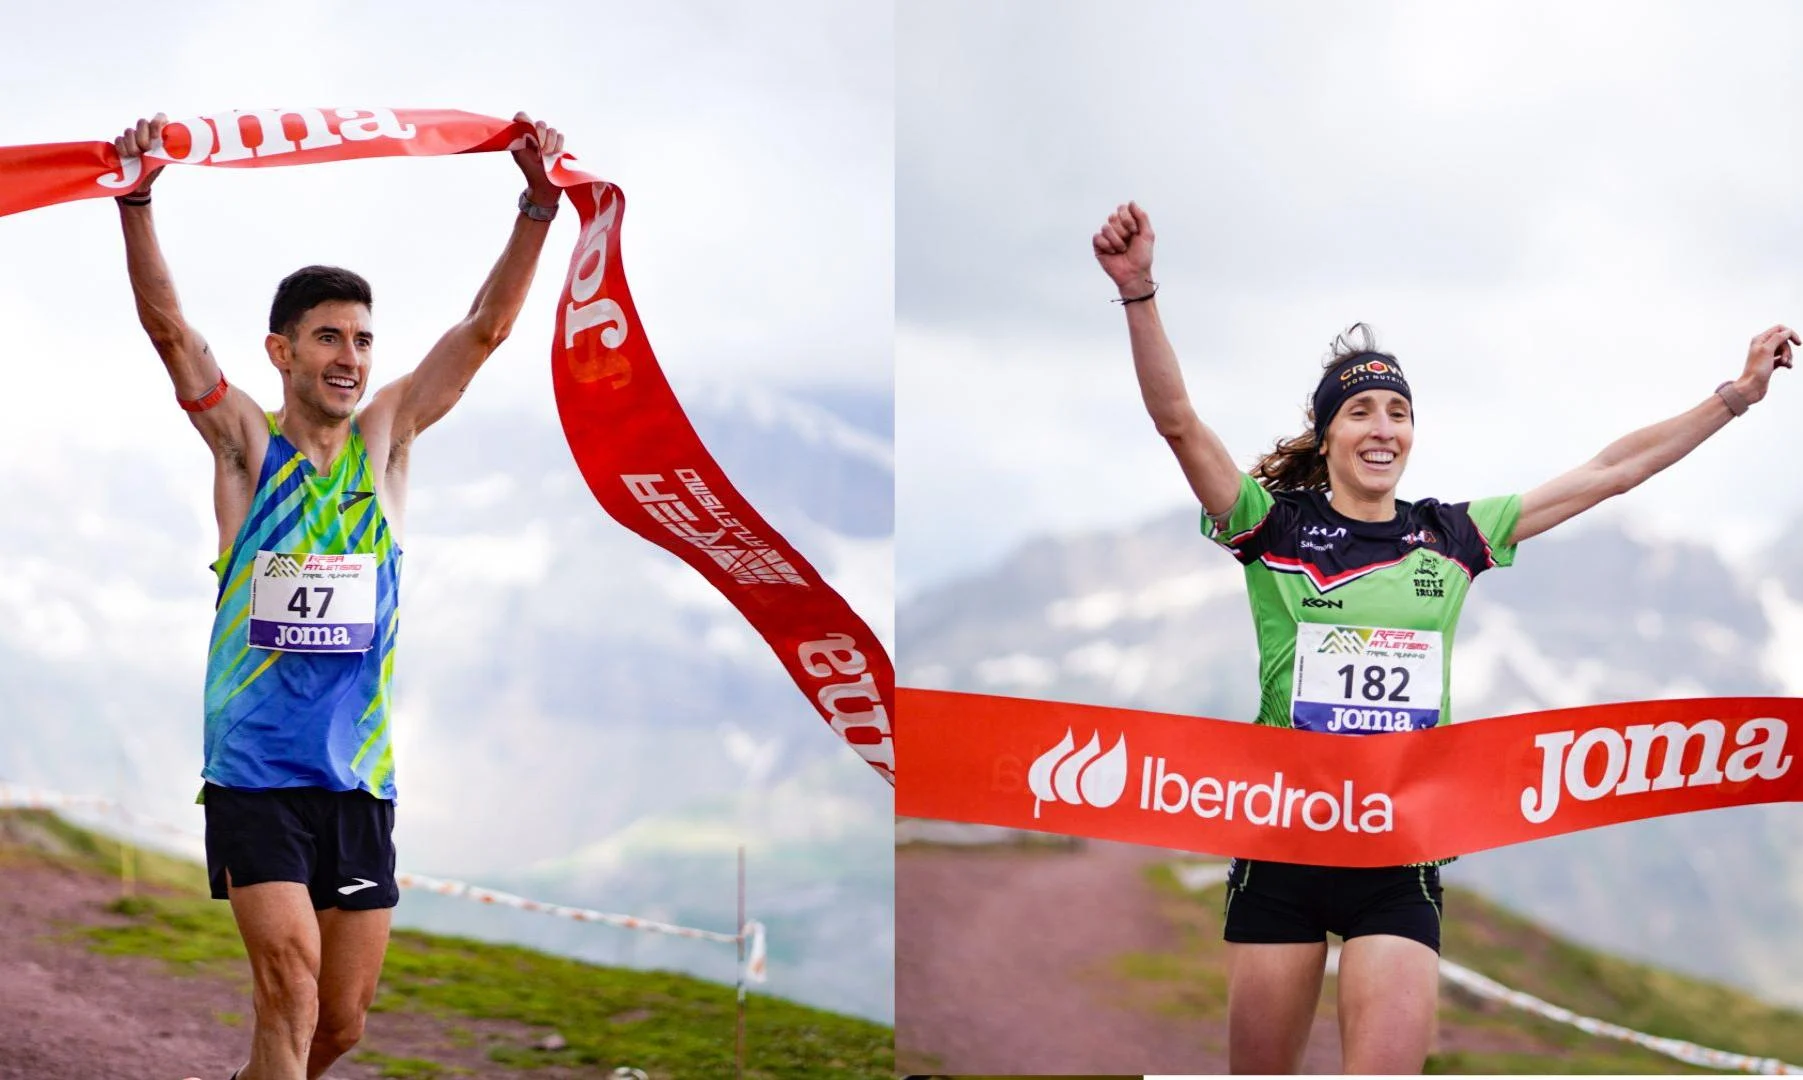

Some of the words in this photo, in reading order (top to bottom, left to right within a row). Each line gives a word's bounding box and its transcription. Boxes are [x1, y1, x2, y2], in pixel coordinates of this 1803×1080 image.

[1340, 360, 1404, 380] CROW
[674, 469, 770, 550] ATLETISMO
[287, 587, 334, 618] 47
[275, 625, 351, 646] Joma
[1337, 664, 1410, 702] 182
[1327, 707, 1413, 732] Joma
[1520, 717, 1793, 824] Joma
[1139, 756, 1394, 833] Iberdrola
